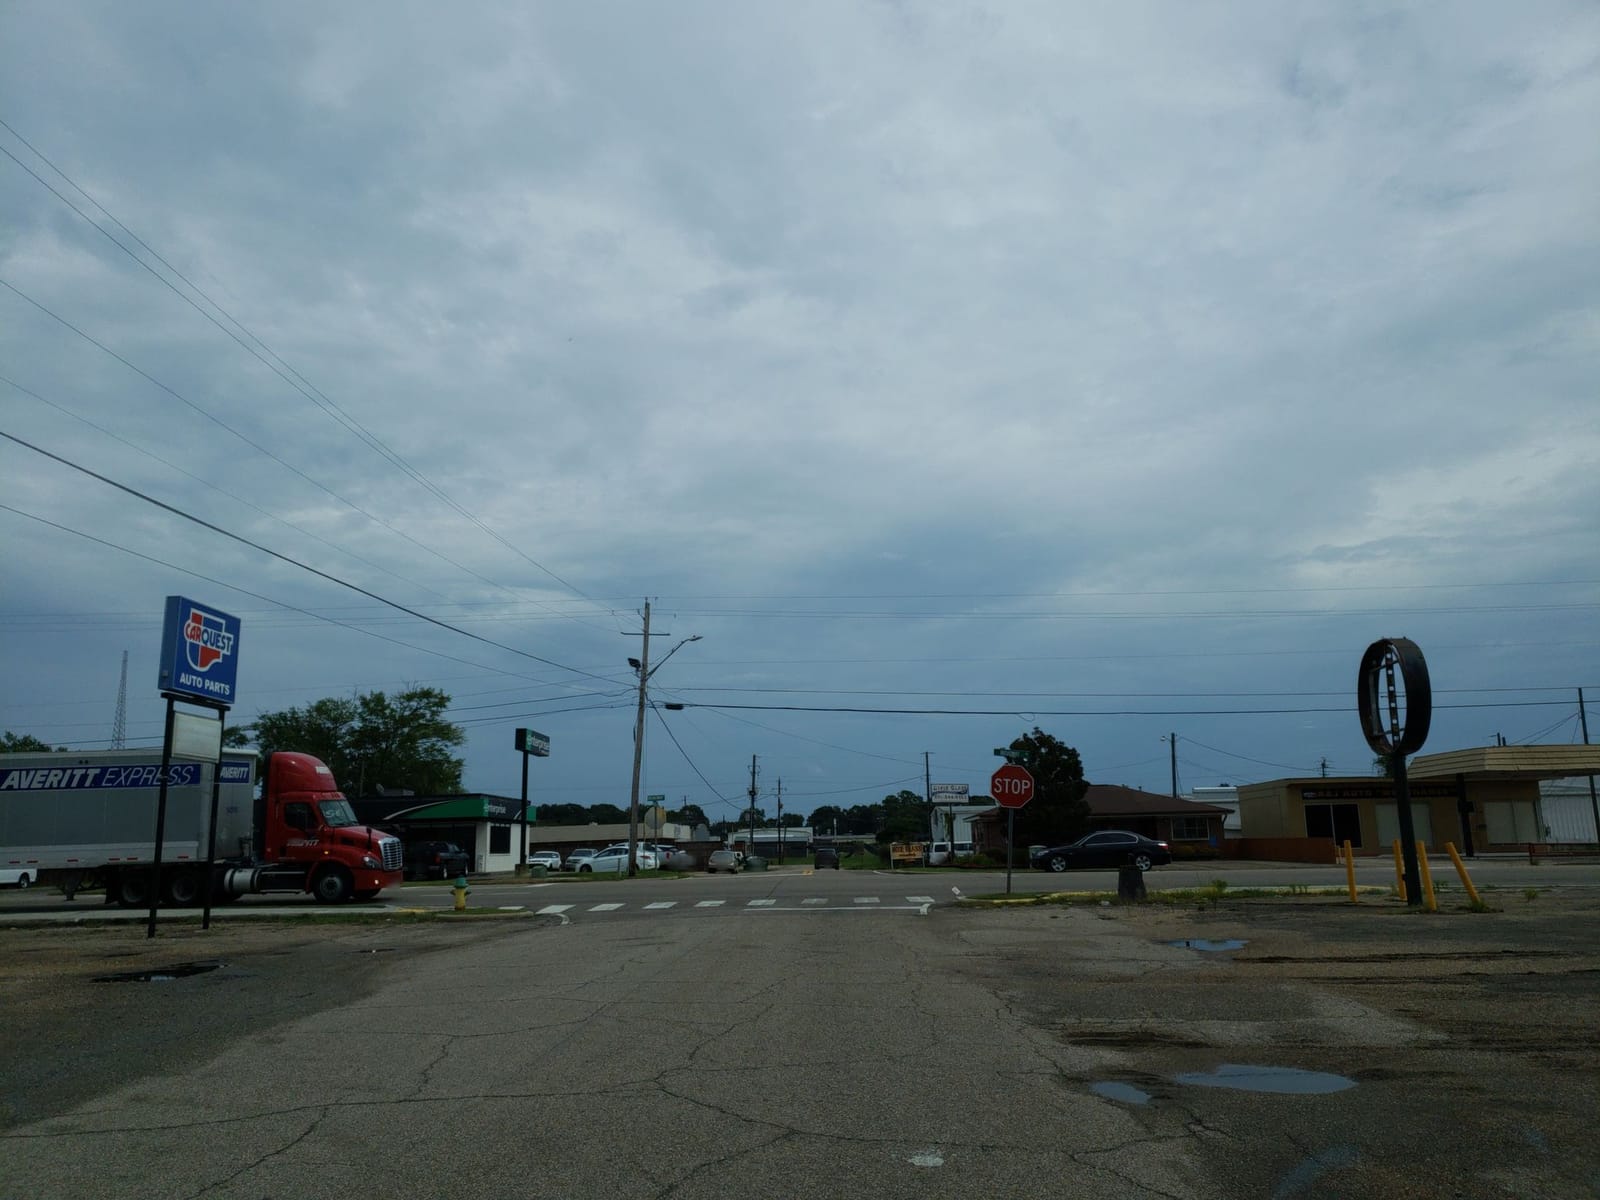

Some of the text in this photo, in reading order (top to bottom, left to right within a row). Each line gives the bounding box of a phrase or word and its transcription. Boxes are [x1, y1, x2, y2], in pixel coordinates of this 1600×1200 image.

[184, 622, 233, 655] CARQUEST
[180, 672, 230, 696] AUTO PARTS
[1, 765, 194, 790] AVERITT EXPRESS
[220, 766, 249, 779] AVERITT
[994, 778, 1031, 795] STOP
